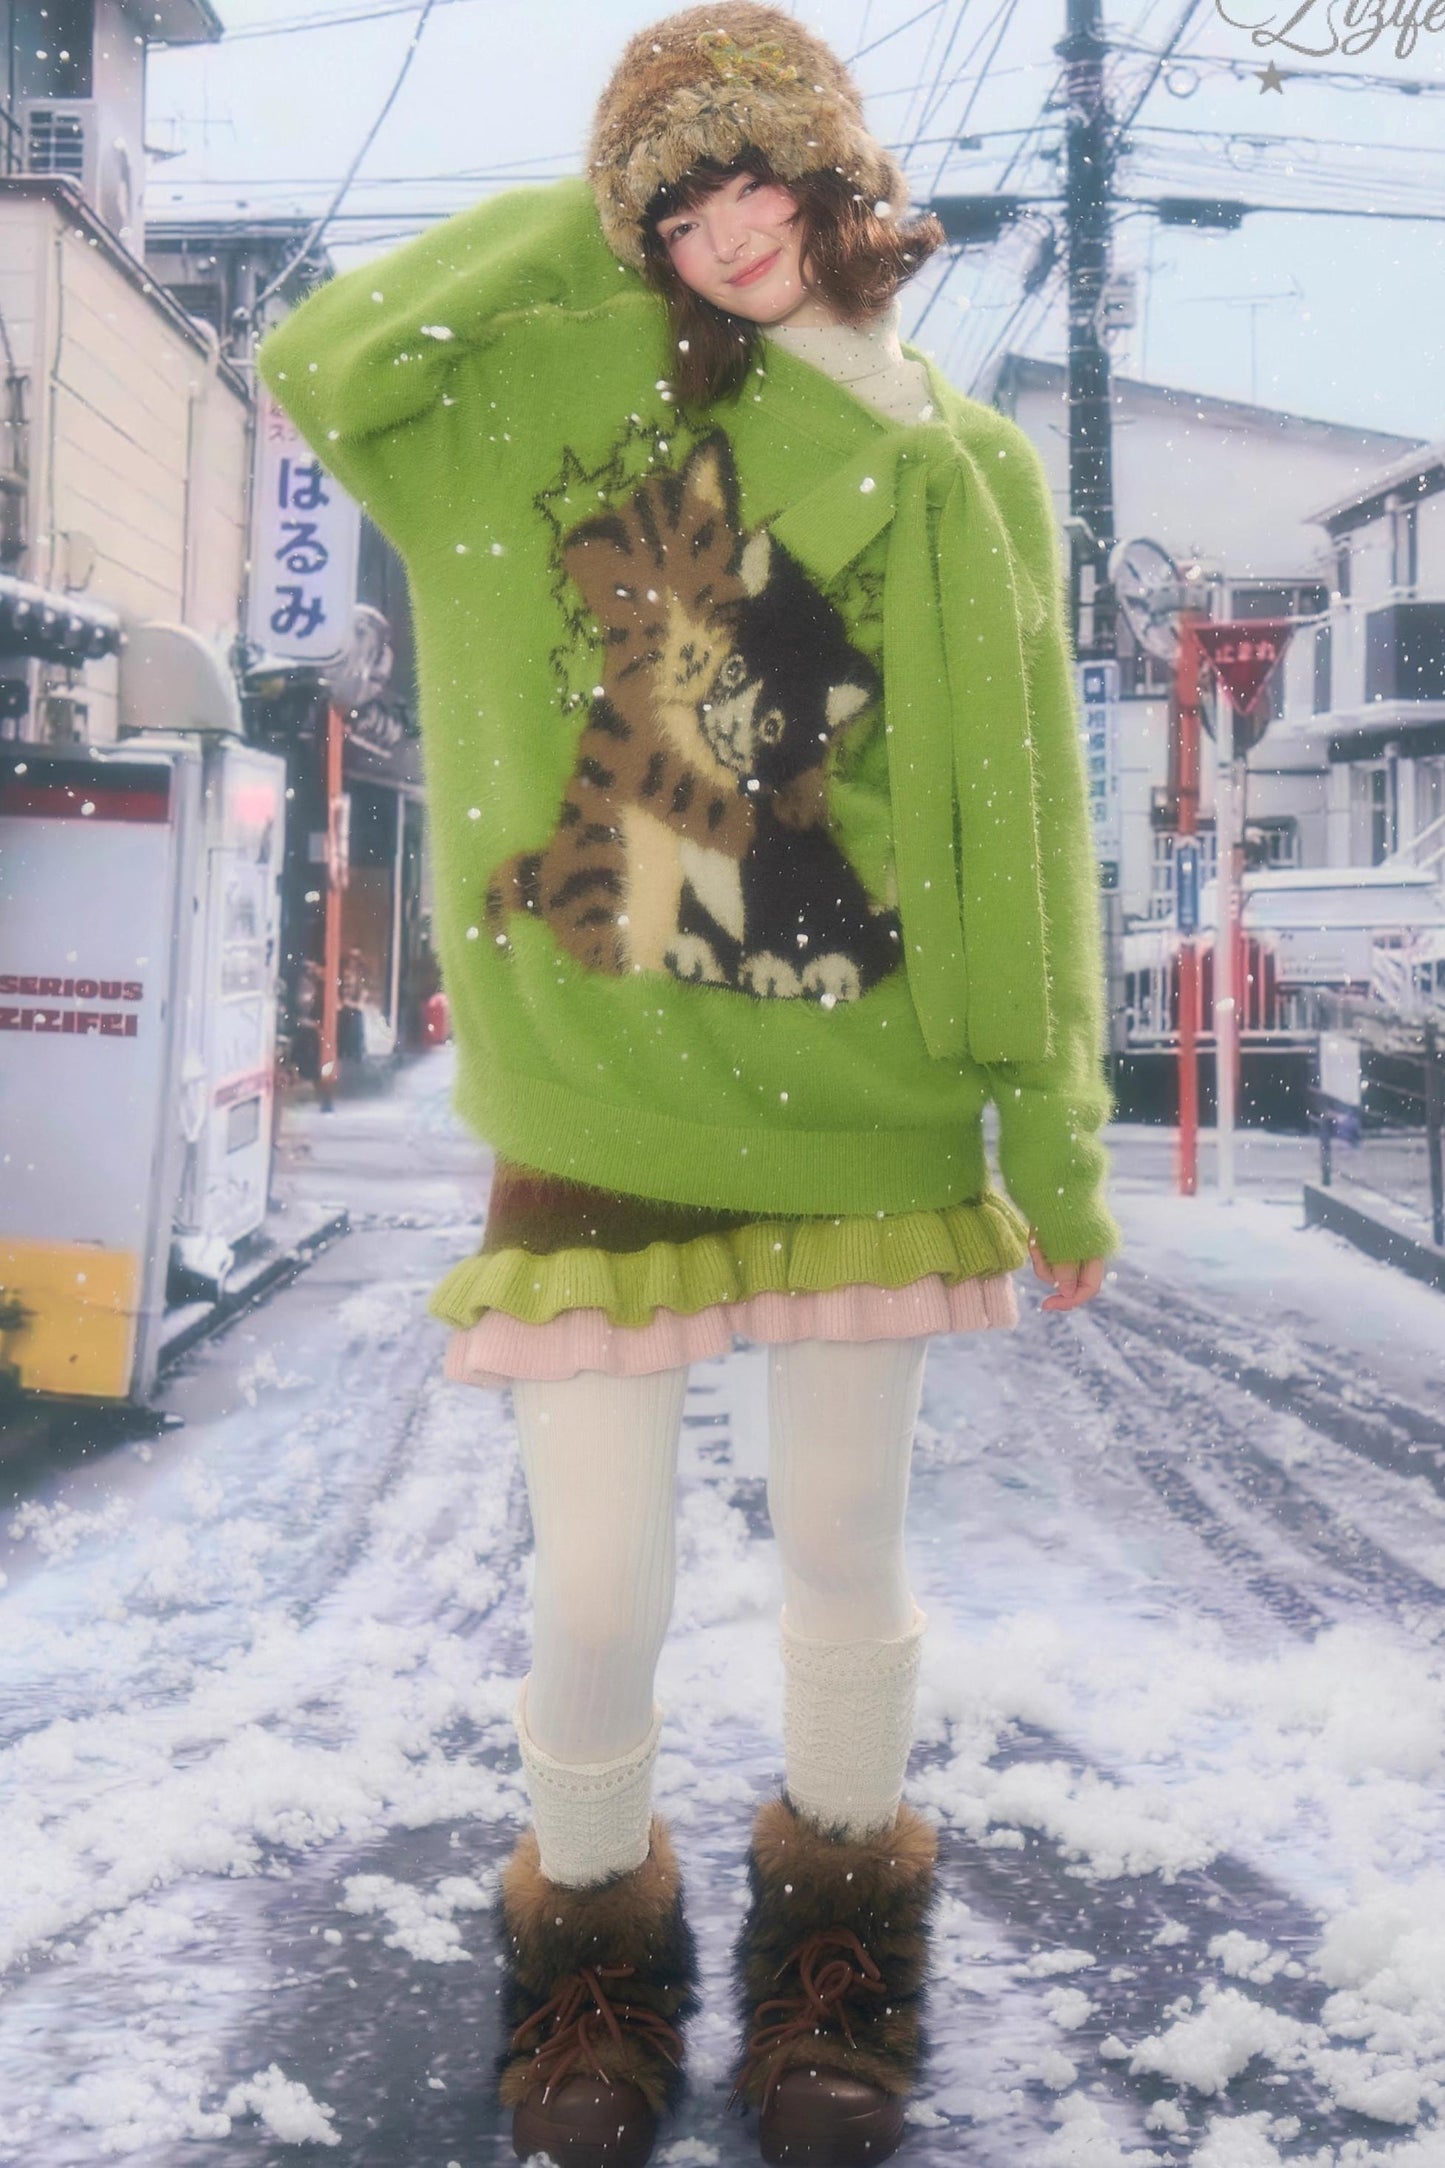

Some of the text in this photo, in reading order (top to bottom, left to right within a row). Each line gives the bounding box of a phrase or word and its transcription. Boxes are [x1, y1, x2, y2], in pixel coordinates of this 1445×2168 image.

[270, 458, 330, 639] はるみ
[0, 974, 144, 1001] SERIOUS
[0, 1007, 138, 1037] ZIZIFEI
